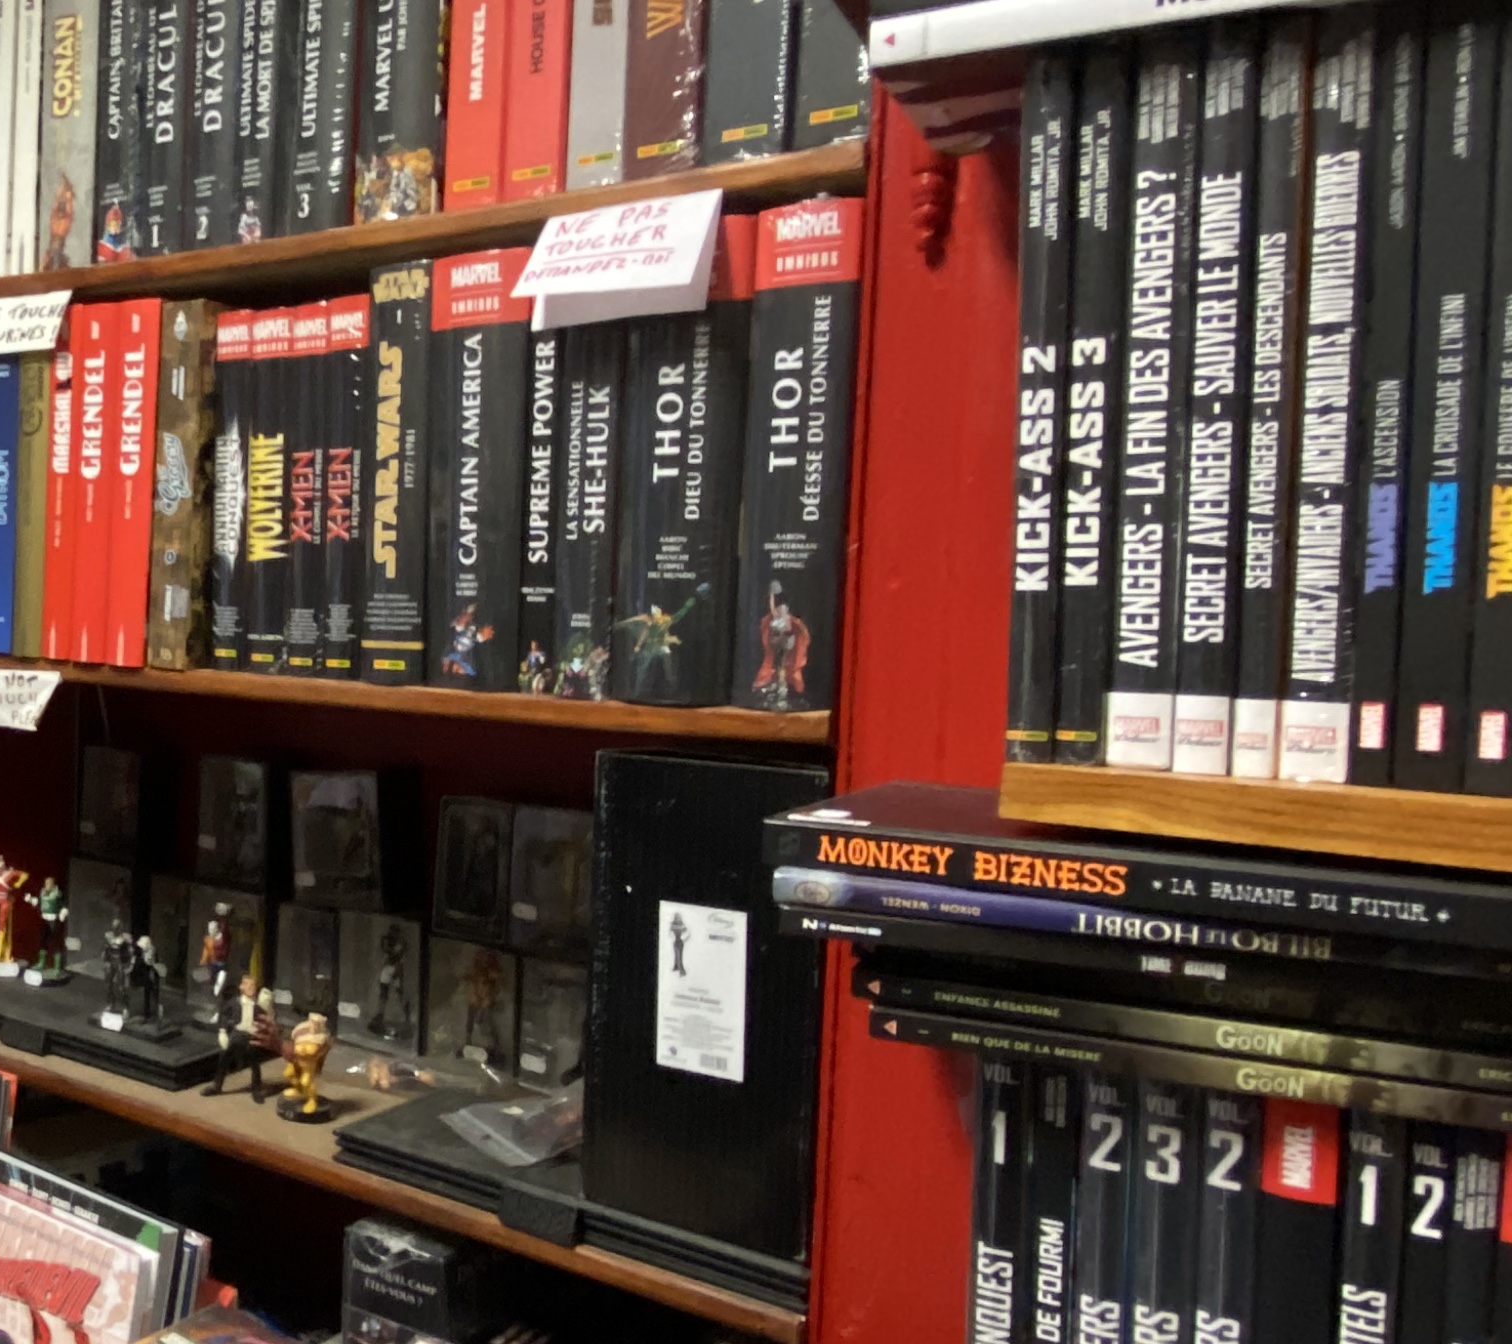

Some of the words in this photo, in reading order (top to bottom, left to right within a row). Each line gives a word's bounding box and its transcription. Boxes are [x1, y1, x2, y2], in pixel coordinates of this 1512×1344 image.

[52, 16, 77, 118] CONAN
[301, 34, 321, 138] ULTIMATE
[374, 19, 392, 113] MARVEL
[468, 1, 487, 101] MARVEL
[528, 15, 545, 76] HOUSE
[1030, 134, 1045, 186] MILLAR
[545, 224, 668, 256] TOUCHER
[554, 213, 600, 238] NE
[618, 202, 672, 227] PAS
[776, 209, 842, 242] MARVEL
[1198, 170, 1243, 261] MONDE
[450, 261, 502, 288] MARVEL
[1131, 192, 1176, 341] AVENGERS
[1197, 263, 1240, 294] LE
[1253, 231, 1288, 367] DESCENDANTS
[463, 332, 483, 450] AMERICA
[533, 339, 557, 435] POWER
[810, 293, 833, 410] TONNERRE
[1022, 344, 1056, 374] 2
[1072, 336, 1107, 366] 3
[1128, 348, 1170, 405] DES
[1192, 297, 1238, 397] SAUVER
[1253, 369, 1282, 404] LES
[80, 350, 106, 480] GRENDEL
[119, 343, 145, 477] GRENDEL
[652, 362, 688, 484] THOR
[768, 345, 805, 473] THOR
[1126, 409, 1167, 456] FIN
[247, 433, 287, 562] WOLVERINE
[528, 437, 550, 564] SUPREME
[582, 383, 613, 534] SHE-HULK
[1015, 387, 1056, 593] KICK-ASS
[1064, 380, 1105, 586] KICK-ASS
[1125, 461, 1166, 496] LA
[1187, 419, 1233, 547] AVENGERS
[1248, 420, 1279, 515] AVENGERS
[456, 455, 480, 567] CAPTAIN
[1245, 519, 1275, 591] SECRET
[1118, 521, 1164, 669] AVENGERS
[1183, 552, 1227, 644] SECRET
[5, 671, 38, 690] NOT
[817, 835, 954, 876] MONKEY
[973, 849, 1129, 896] BIZNESS
[1169, 877, 1197, 897] LA
[1210, 881, 1297, 908] BANANE
[1350, 896, 1429, 923] FUTUR
[951, 1031, 980, 1044] BIEN
[983, 1036, 1010, 1049] QUE
[1088, 1112, 1124, 1173] 2
[1145, 1124, 1182, 1185] 3
[1206, 1129, 1245, 1192] 2
[1359, 1164, 1378, 1226] 1
[1410, 1174, 1445, 1240] 2
[1039, 1217, 1066, 1303] FOURMI
